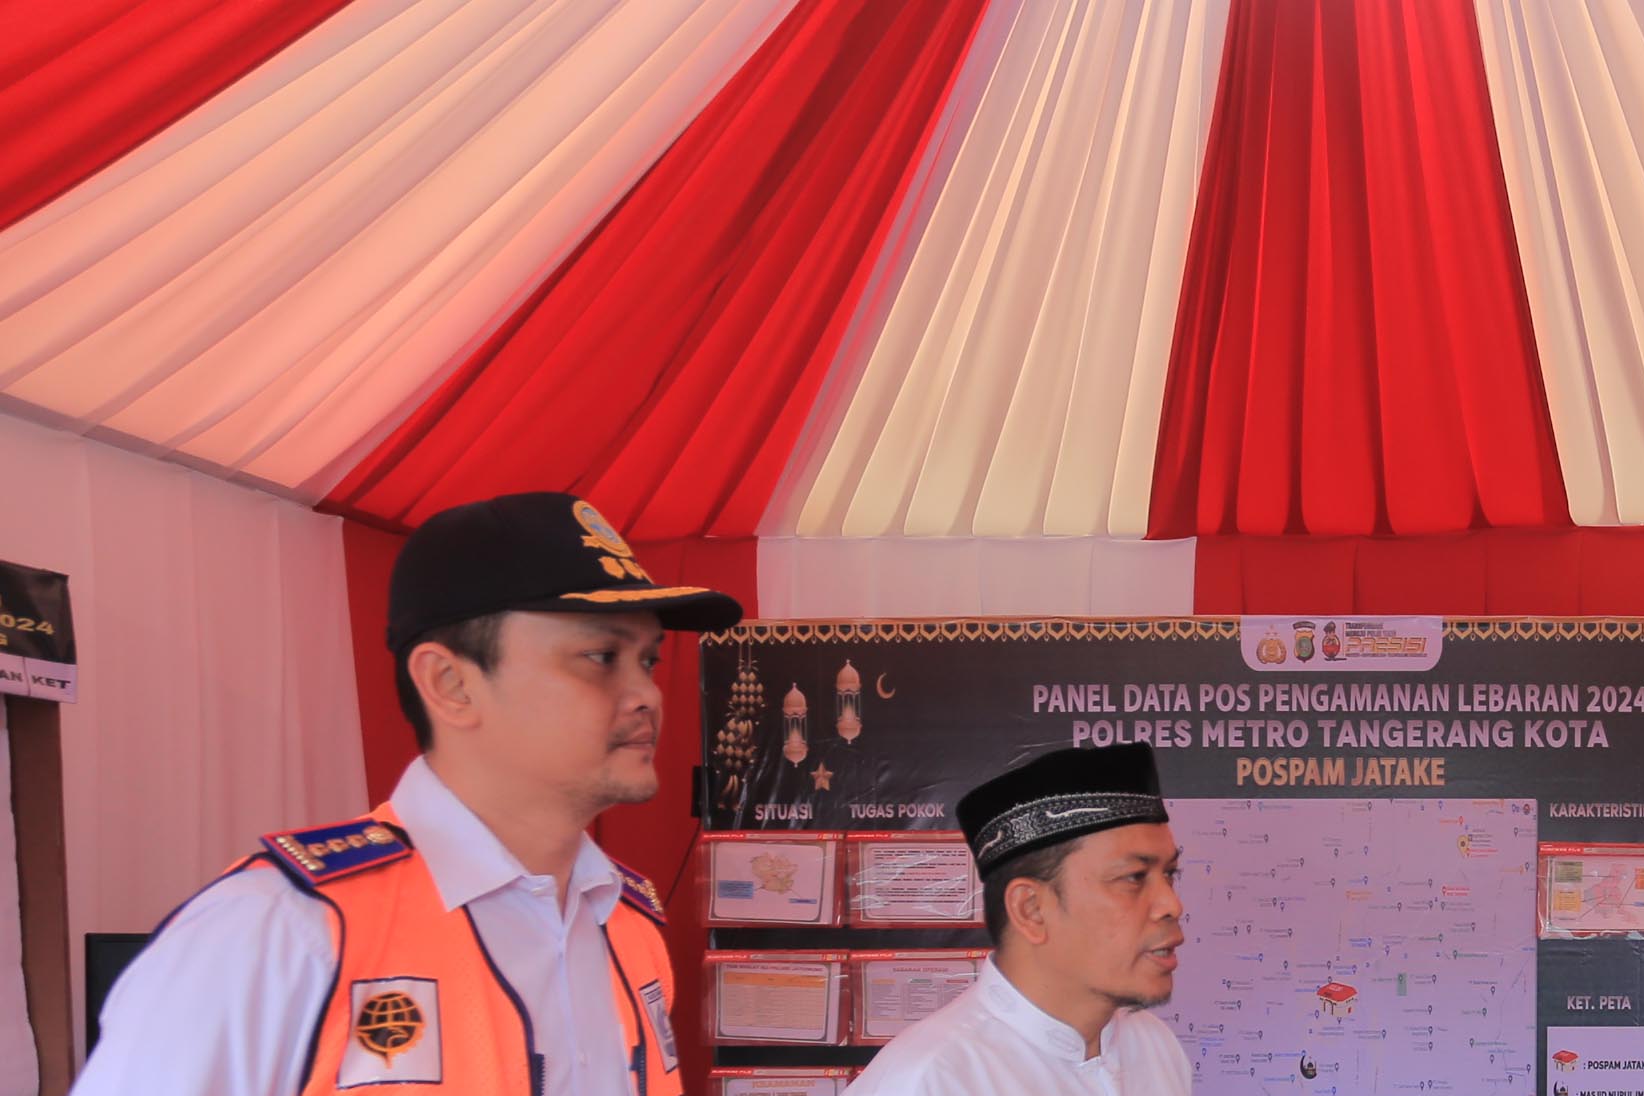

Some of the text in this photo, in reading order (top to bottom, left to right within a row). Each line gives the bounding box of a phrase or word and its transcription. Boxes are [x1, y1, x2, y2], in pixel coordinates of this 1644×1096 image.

[0, 614, 55, 635] 024
[1033, 684, 1116, 713] PANEL
[1124, 684, 1191, 713] DATA
[1199, 684, 1251, 713] POS
[1259, 684, 1450, 713] PENGAMANAN
[1458, 684, 1579, 713] LEBARAN
[1073, 720, 1609, 748] POLRES METRO TANGERANG KOTA
[1237, 757, 1445, 786] POSPAM JATAKE
[755, 803, 813, 820] SITUASI
[850, 803, 945, 819] TUGAS POKOK
[1567, 996, 1632, 1010] KET. PETA
[1588, 1061, 1621, 1070] POSPAM
